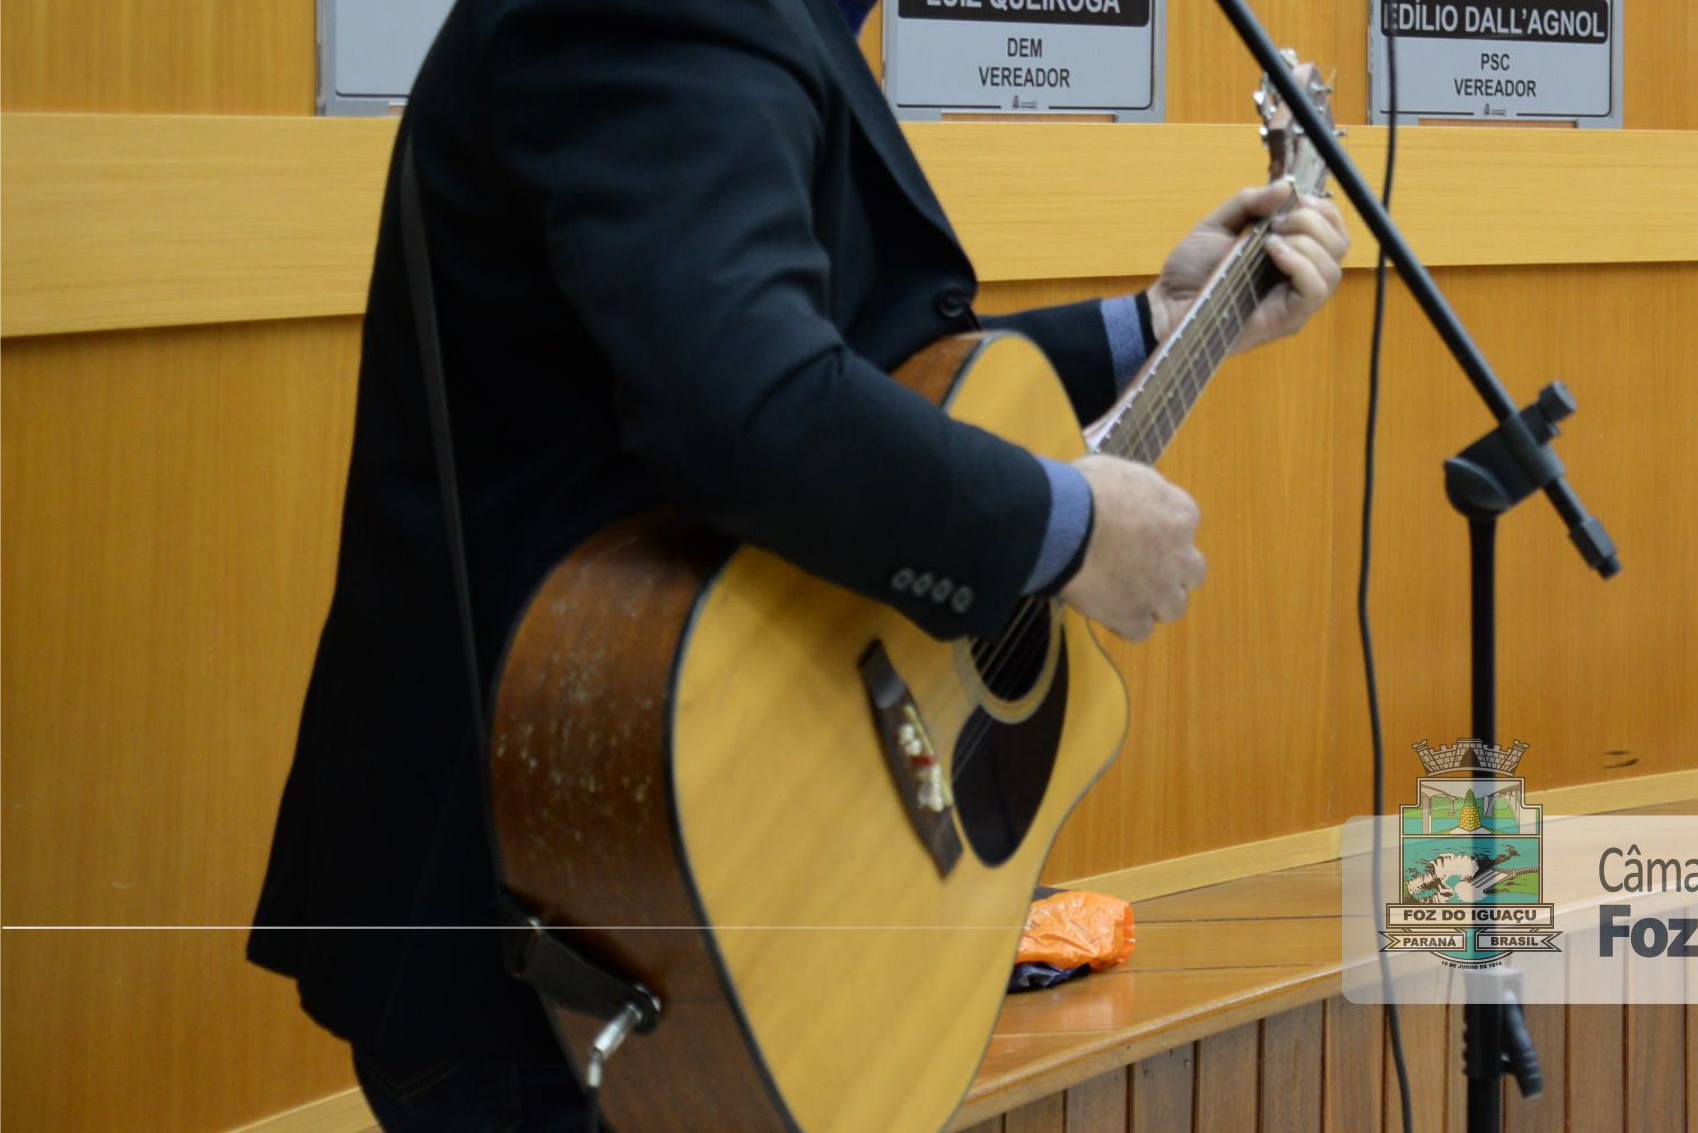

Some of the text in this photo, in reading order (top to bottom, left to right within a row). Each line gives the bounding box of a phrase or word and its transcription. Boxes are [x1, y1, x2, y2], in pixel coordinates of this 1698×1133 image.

[1464, 6, 1606, 38] DALL'AGNOL
[1007, 37, 1043, 58] DEM
[1480, 52, 1511, 71] PSC
[978, 66, 1071, 88] VEREADOR
[1453, 77, 1537, 98] VEREADOR
